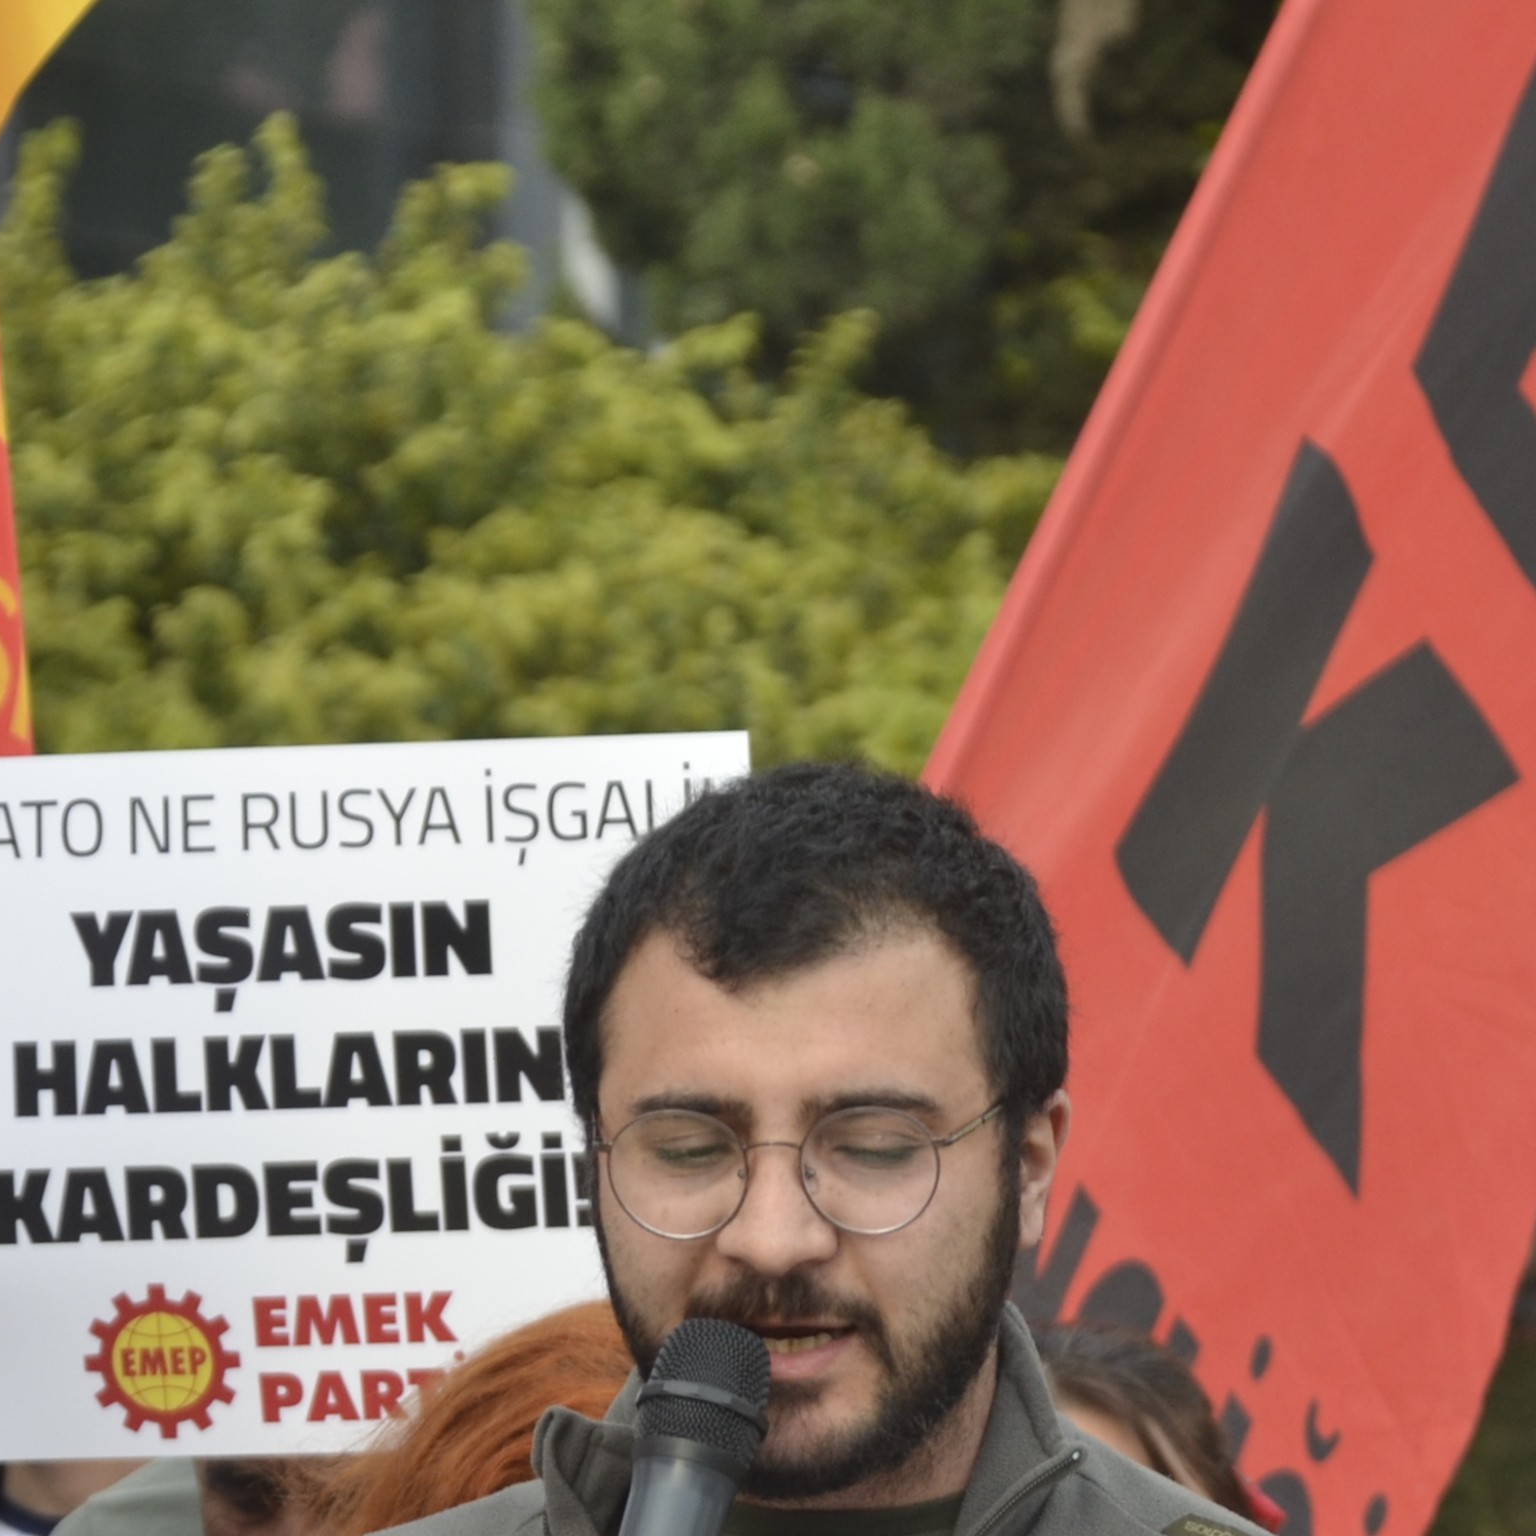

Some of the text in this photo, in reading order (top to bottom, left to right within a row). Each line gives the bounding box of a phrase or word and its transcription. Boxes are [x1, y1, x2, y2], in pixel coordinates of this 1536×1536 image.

[129, 794, 216, 855] NE
[241, 786, 462, 852] RUSYA
[71, 900, 493, 1013] YAŞASIN
[13, 1024, 566, 1118] HALKLARIN
[252, 1291, 458, 1348] EMEK
[120, 1341, 213, 1378] EMEP
